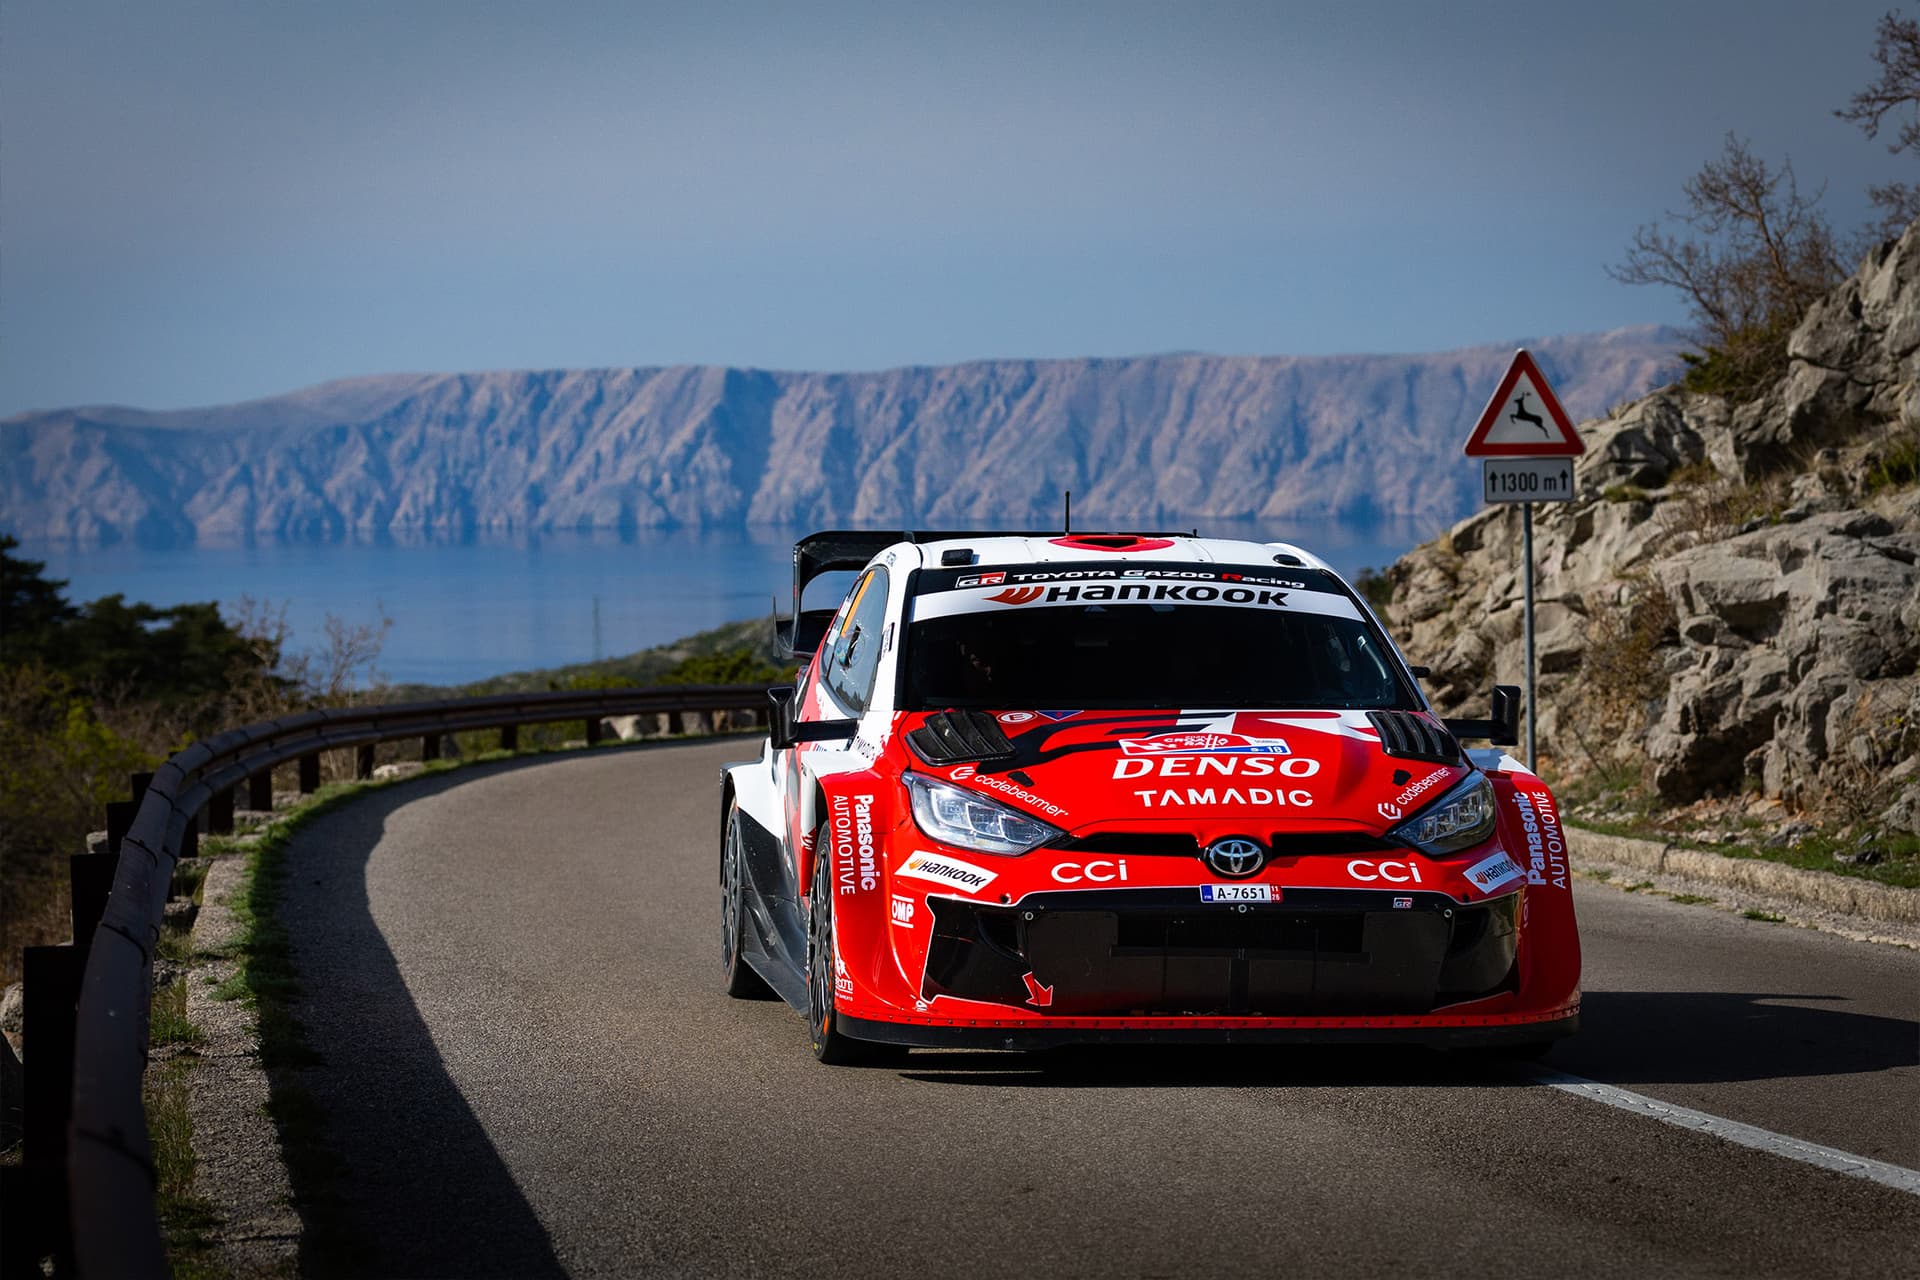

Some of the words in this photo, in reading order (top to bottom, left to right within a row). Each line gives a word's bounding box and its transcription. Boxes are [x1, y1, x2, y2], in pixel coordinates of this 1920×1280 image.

[1500, 472, 1538, 492] 1300
[1543, 476, 1557, 491] m
[957, 575, 1003, 588] GR
[1012, 570, 1116, 581] TOYOTA
[1123, 569, 1216, 579] GAZOO
[1221, 573, 1305, 589] Racing
[1045, 584, 1290, 607] HANKOOK
[1111, 756, 1321, 780] DENSO
[974, 774, 1066, 817] codebeamer
[1134, 787, 1314, 807] TAMADIC
[1396, 767, 1451, 805] codebeamer
[833, 795, 856, 895] AUTOMOTIVE
[853, 794, 880, 891] Panasonic
[1512, 791, 1547, 885] Panasonic
[1532, 791, 1566, 889] AUTOMOTIVE
[917, 859, 987, 887] HANKOOK
[1217, 887, 1266, 900] A-7651
[1394, 899, 1412, 908] GR
[891, 899, 915, 922] OMP
